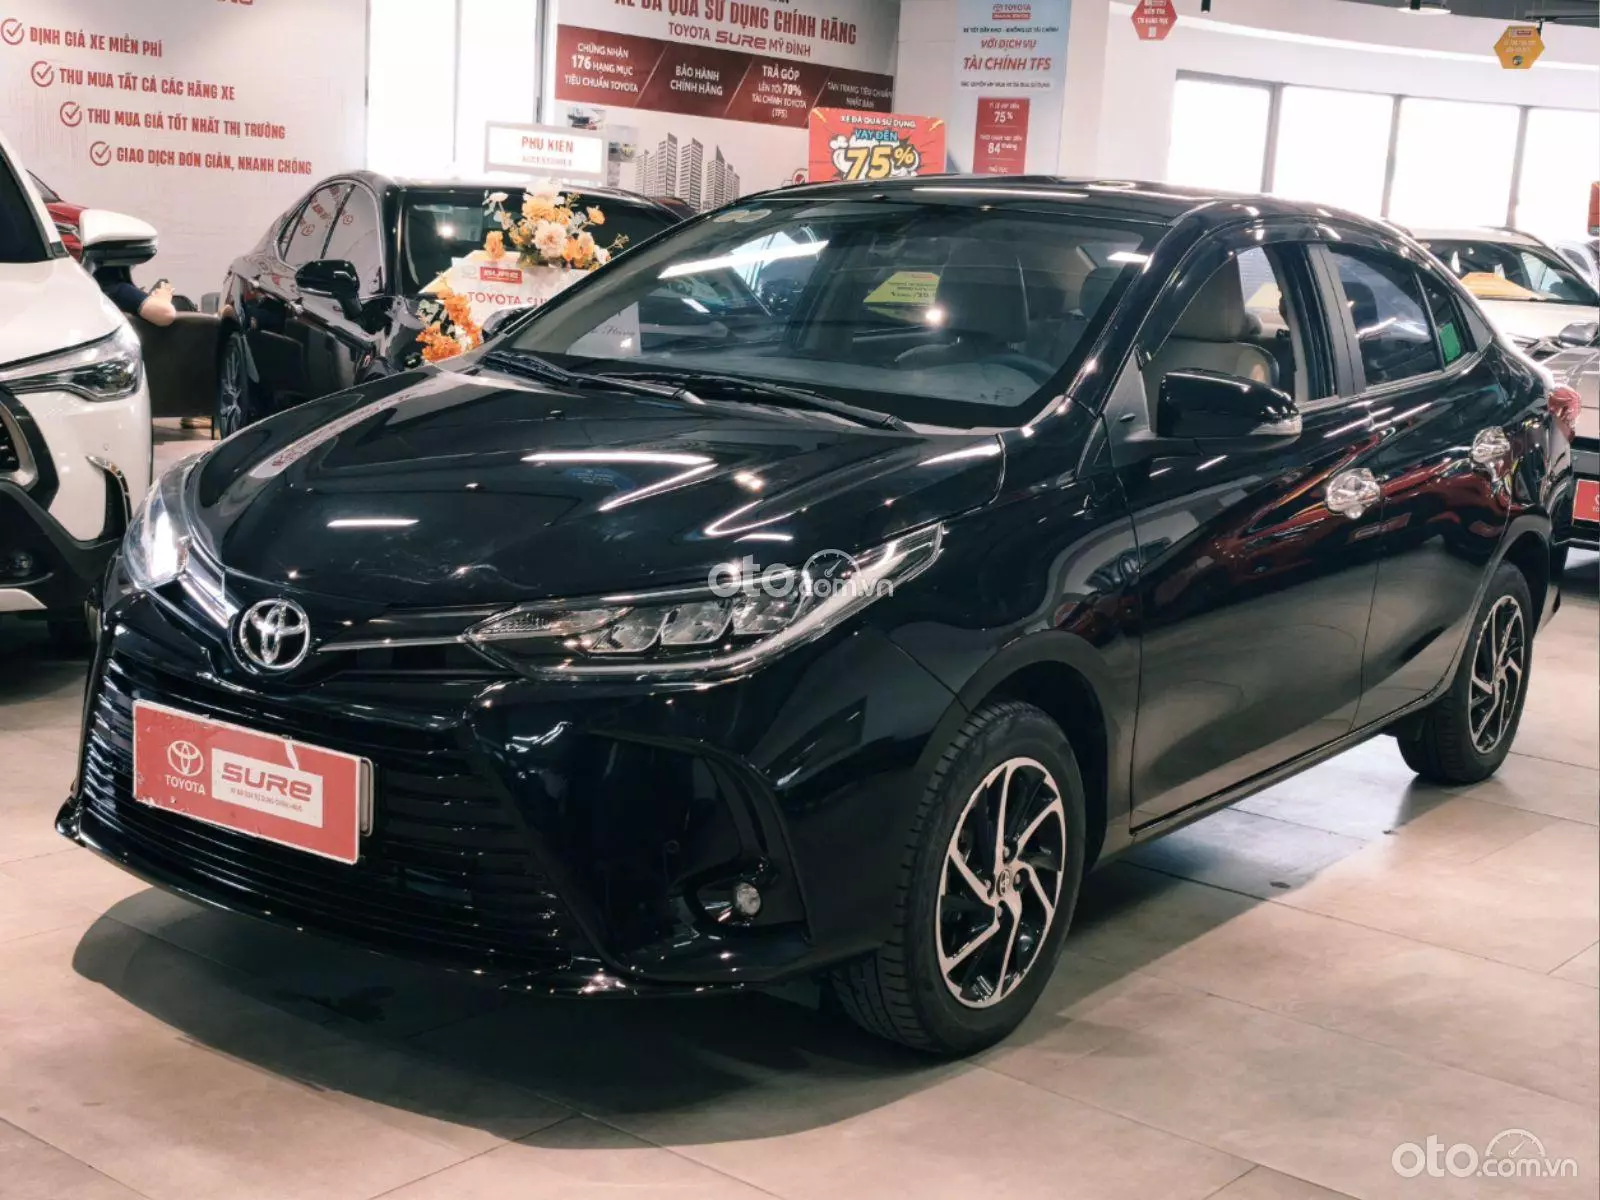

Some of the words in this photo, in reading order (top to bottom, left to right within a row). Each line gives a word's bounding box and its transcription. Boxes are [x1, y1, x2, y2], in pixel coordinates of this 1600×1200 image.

[730, 2, 769, 29] DỤNG
[774, 9, 816, 38] CHÍNH
[820, 17, 857, 45] HÃNG
[30, 26, 60, 46] ĐỊNH
[65, 29, 85, 48] GIÁ
[90, 34, 105, 51] XE
[109, 32, 138, 54] MIỄN
[143, 40, 162, 57] PHÍ
[668, 22, 711, 41] TOYOTA
[785, 41, 811, 57] ĐÌNH
[999, 39, 1021, 51] DỊCH
[571, 55, 592, 70] 176
[985, 54, 1028, 70] CHÍNH
[59, 68, 83, 86] THU
[88, 71, 114, 89] MUA
[118, 72, 138, 92] TẤT
[161, 77, 184, 96] CÁC
[187, 80, 218, 99] HÃNG
[221, 86, 235, 101] XE
[610, 80, 639, 93] TOYOTA
[782, 83, 802, 97] 70%
[88, 108, 110, 124] THU
[114, 110, 141, 128] MUA
[144, 111, 164, 130] GIÁ
[167, 113, 188, 131] TỐT
[192, 115, 220, 134] NHẤT
[224, 120, 241, 138] THỊ
[244, 121, 286, 140] TRƯỜNG
[864, 117, 880, 125] QUA
[855, 128, 876, 140] VAY
[988, 142, 1001, 154] 84
[116, 147, 144, 164] GIAO
[148, 149, 175, 167] DỊCH
[238, 155, 274, 173] NHANH
[278, 157, 312, 175] CHÓNG
[844, 144, 915, 180] 75%
[468, 291, 521, 305] TOYOTA
[164, 774, 206, 796] TOYOTA
